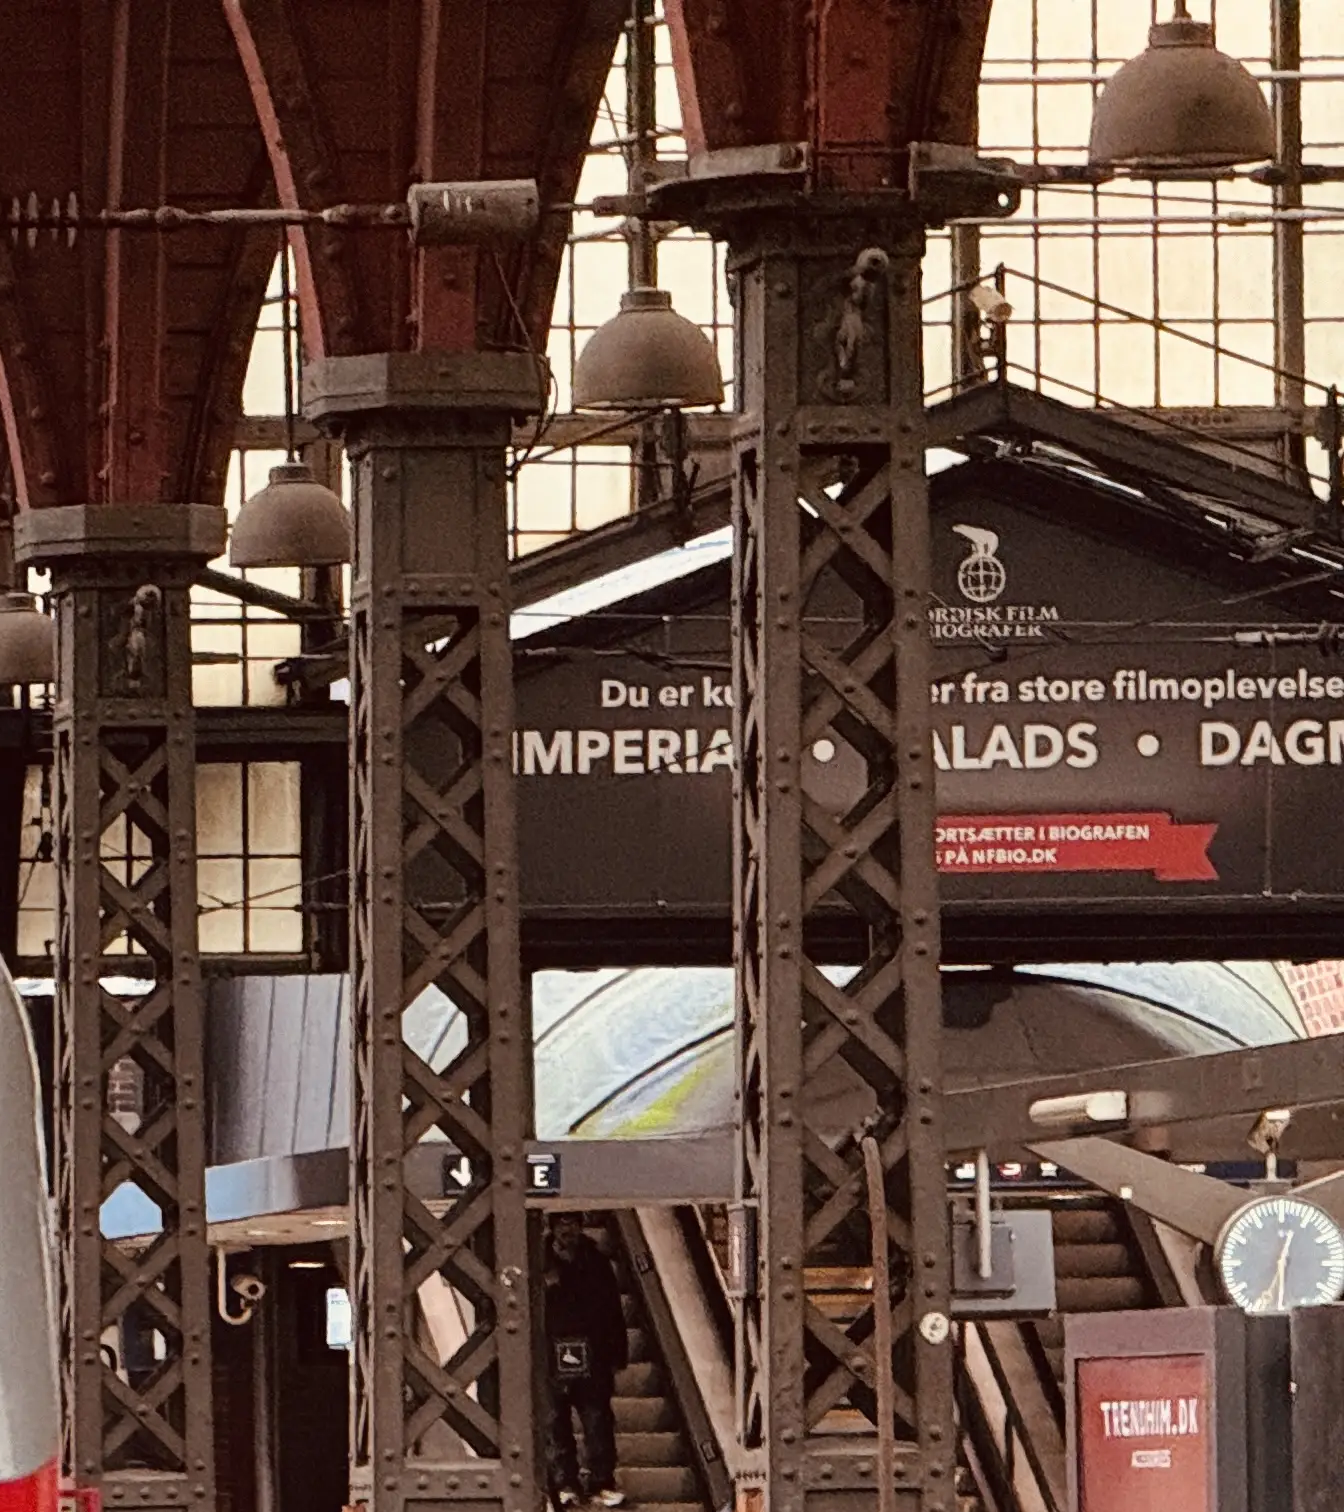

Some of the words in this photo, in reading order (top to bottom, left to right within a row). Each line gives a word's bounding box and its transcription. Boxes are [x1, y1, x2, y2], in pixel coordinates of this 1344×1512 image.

[601, 679, 650, 708] Du
[658, 684, 694, 708] er
[962, 672, 1009, 703] fra
[1018, 675, 1105, 703] store
[1050, 825, 1150, 841] BIOGRAFEN
[972, 848, 1057, 864] NFBIO.DK
[533, 1165, 550, 1187] E
[1100, 1398, 1199, 1437] TRENDHIM.DK
